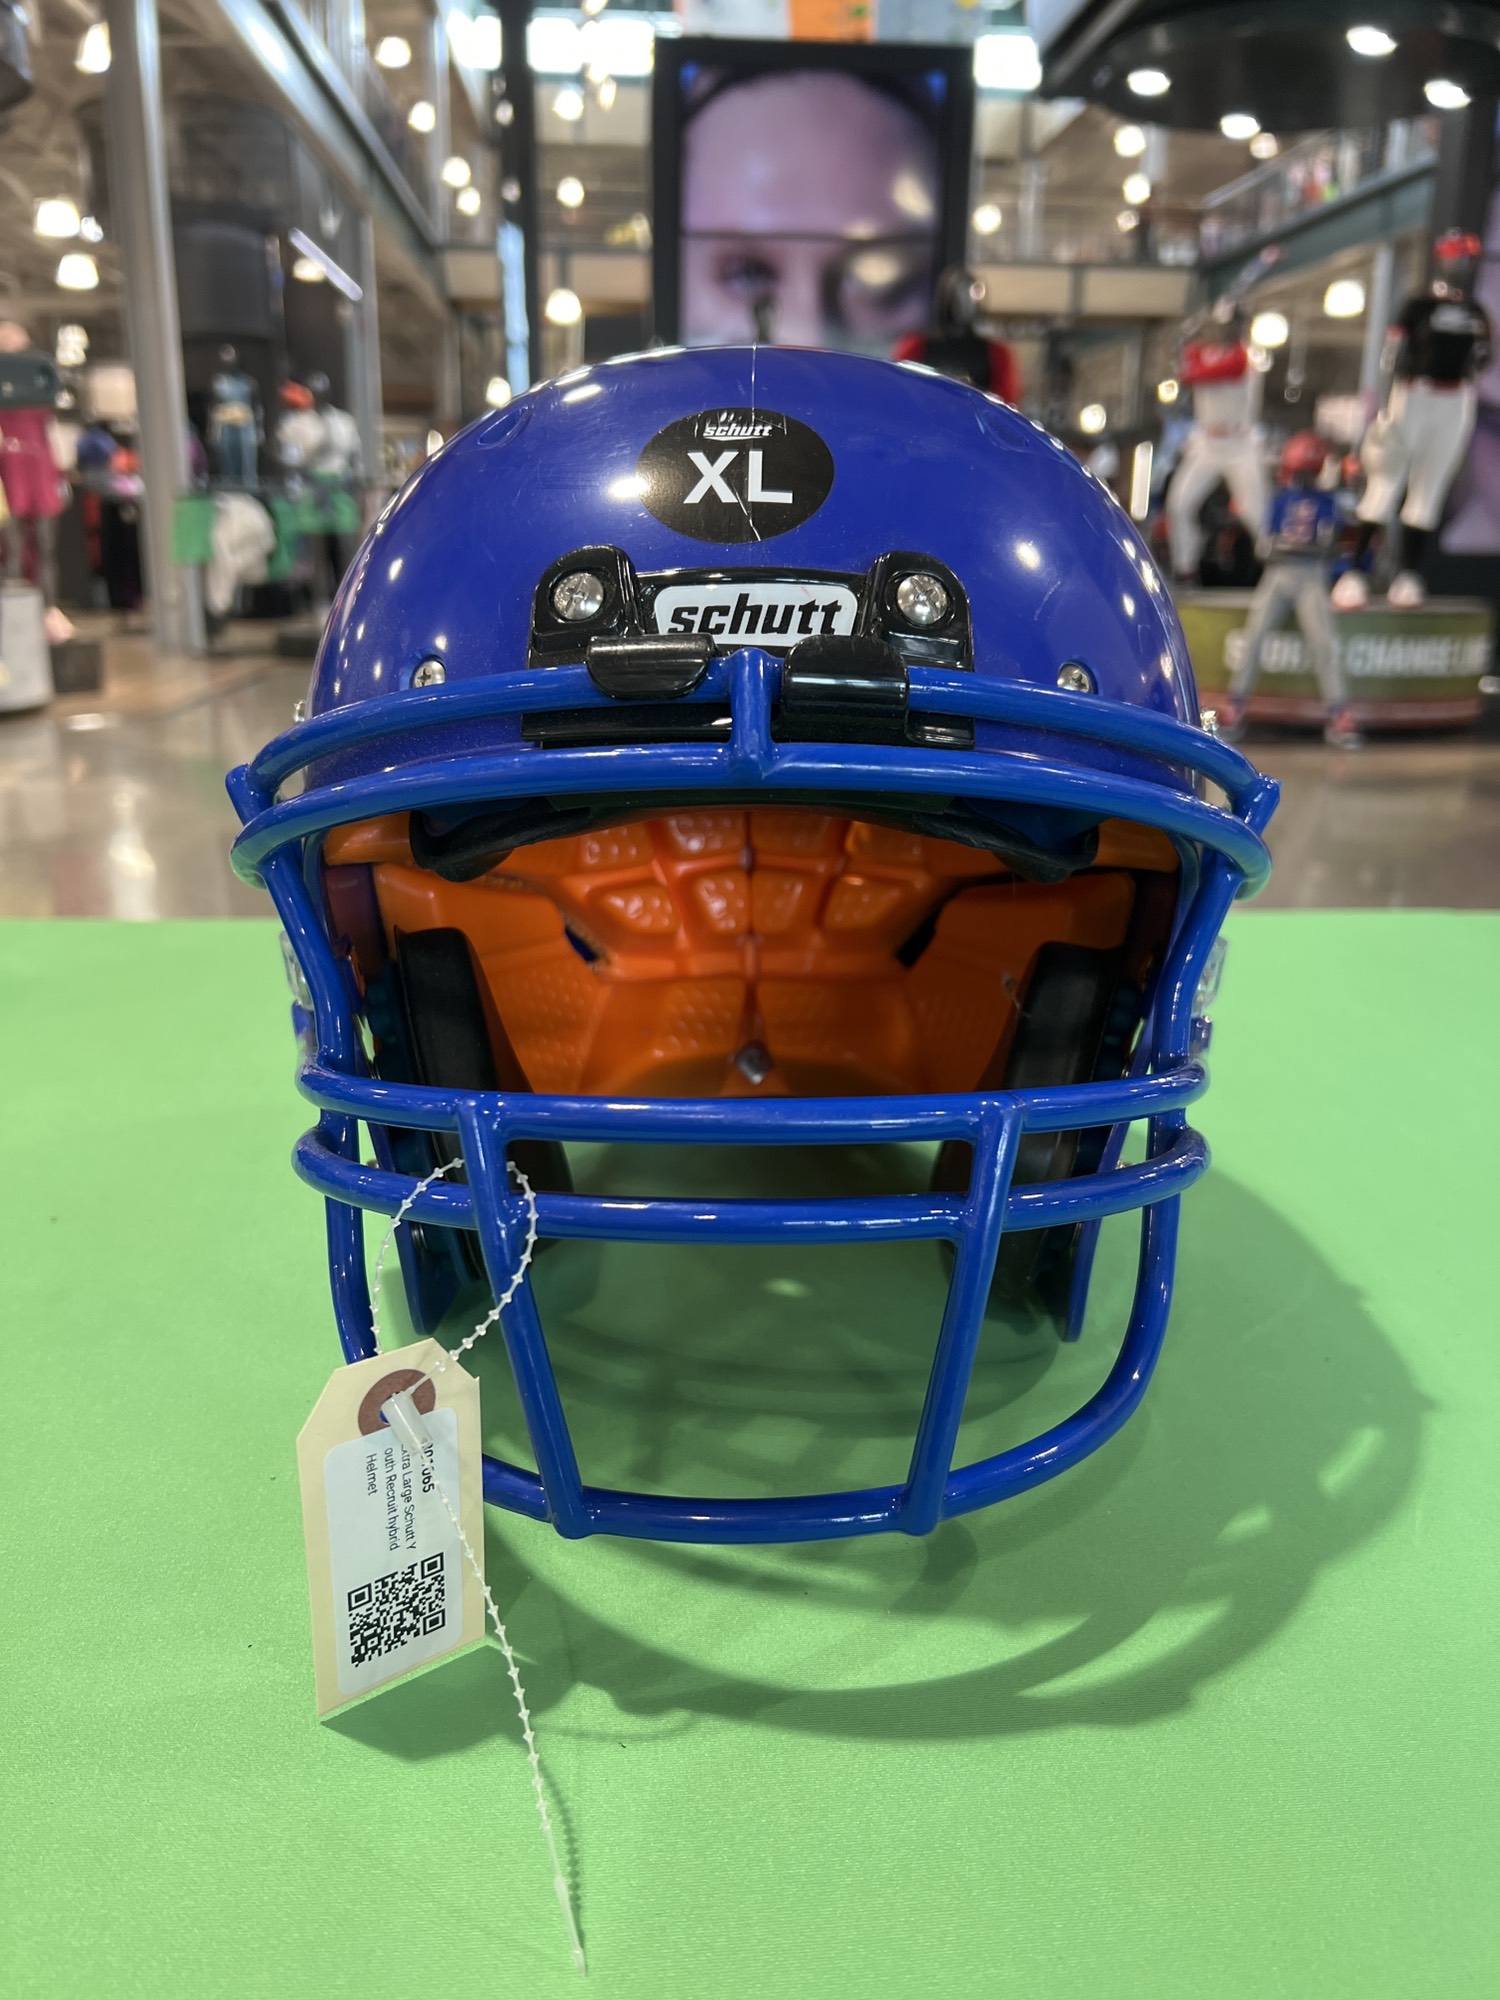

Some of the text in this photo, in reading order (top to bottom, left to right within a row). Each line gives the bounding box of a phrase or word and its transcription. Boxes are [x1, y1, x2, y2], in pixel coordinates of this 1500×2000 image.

[703, 423, 772, 437] schutt
[683, 450, 793, 504] XL
[668, 593, 842, 635] schutt
[366, 1453, 378, 1496] Helmet
[401, 1471, 413, 1503] Large
[384, 1447, 401, 1551] outh Recruit hybrid
[404, 1504, 416, 1541] Schutt
[406, 1541, 417, 1550] Y
